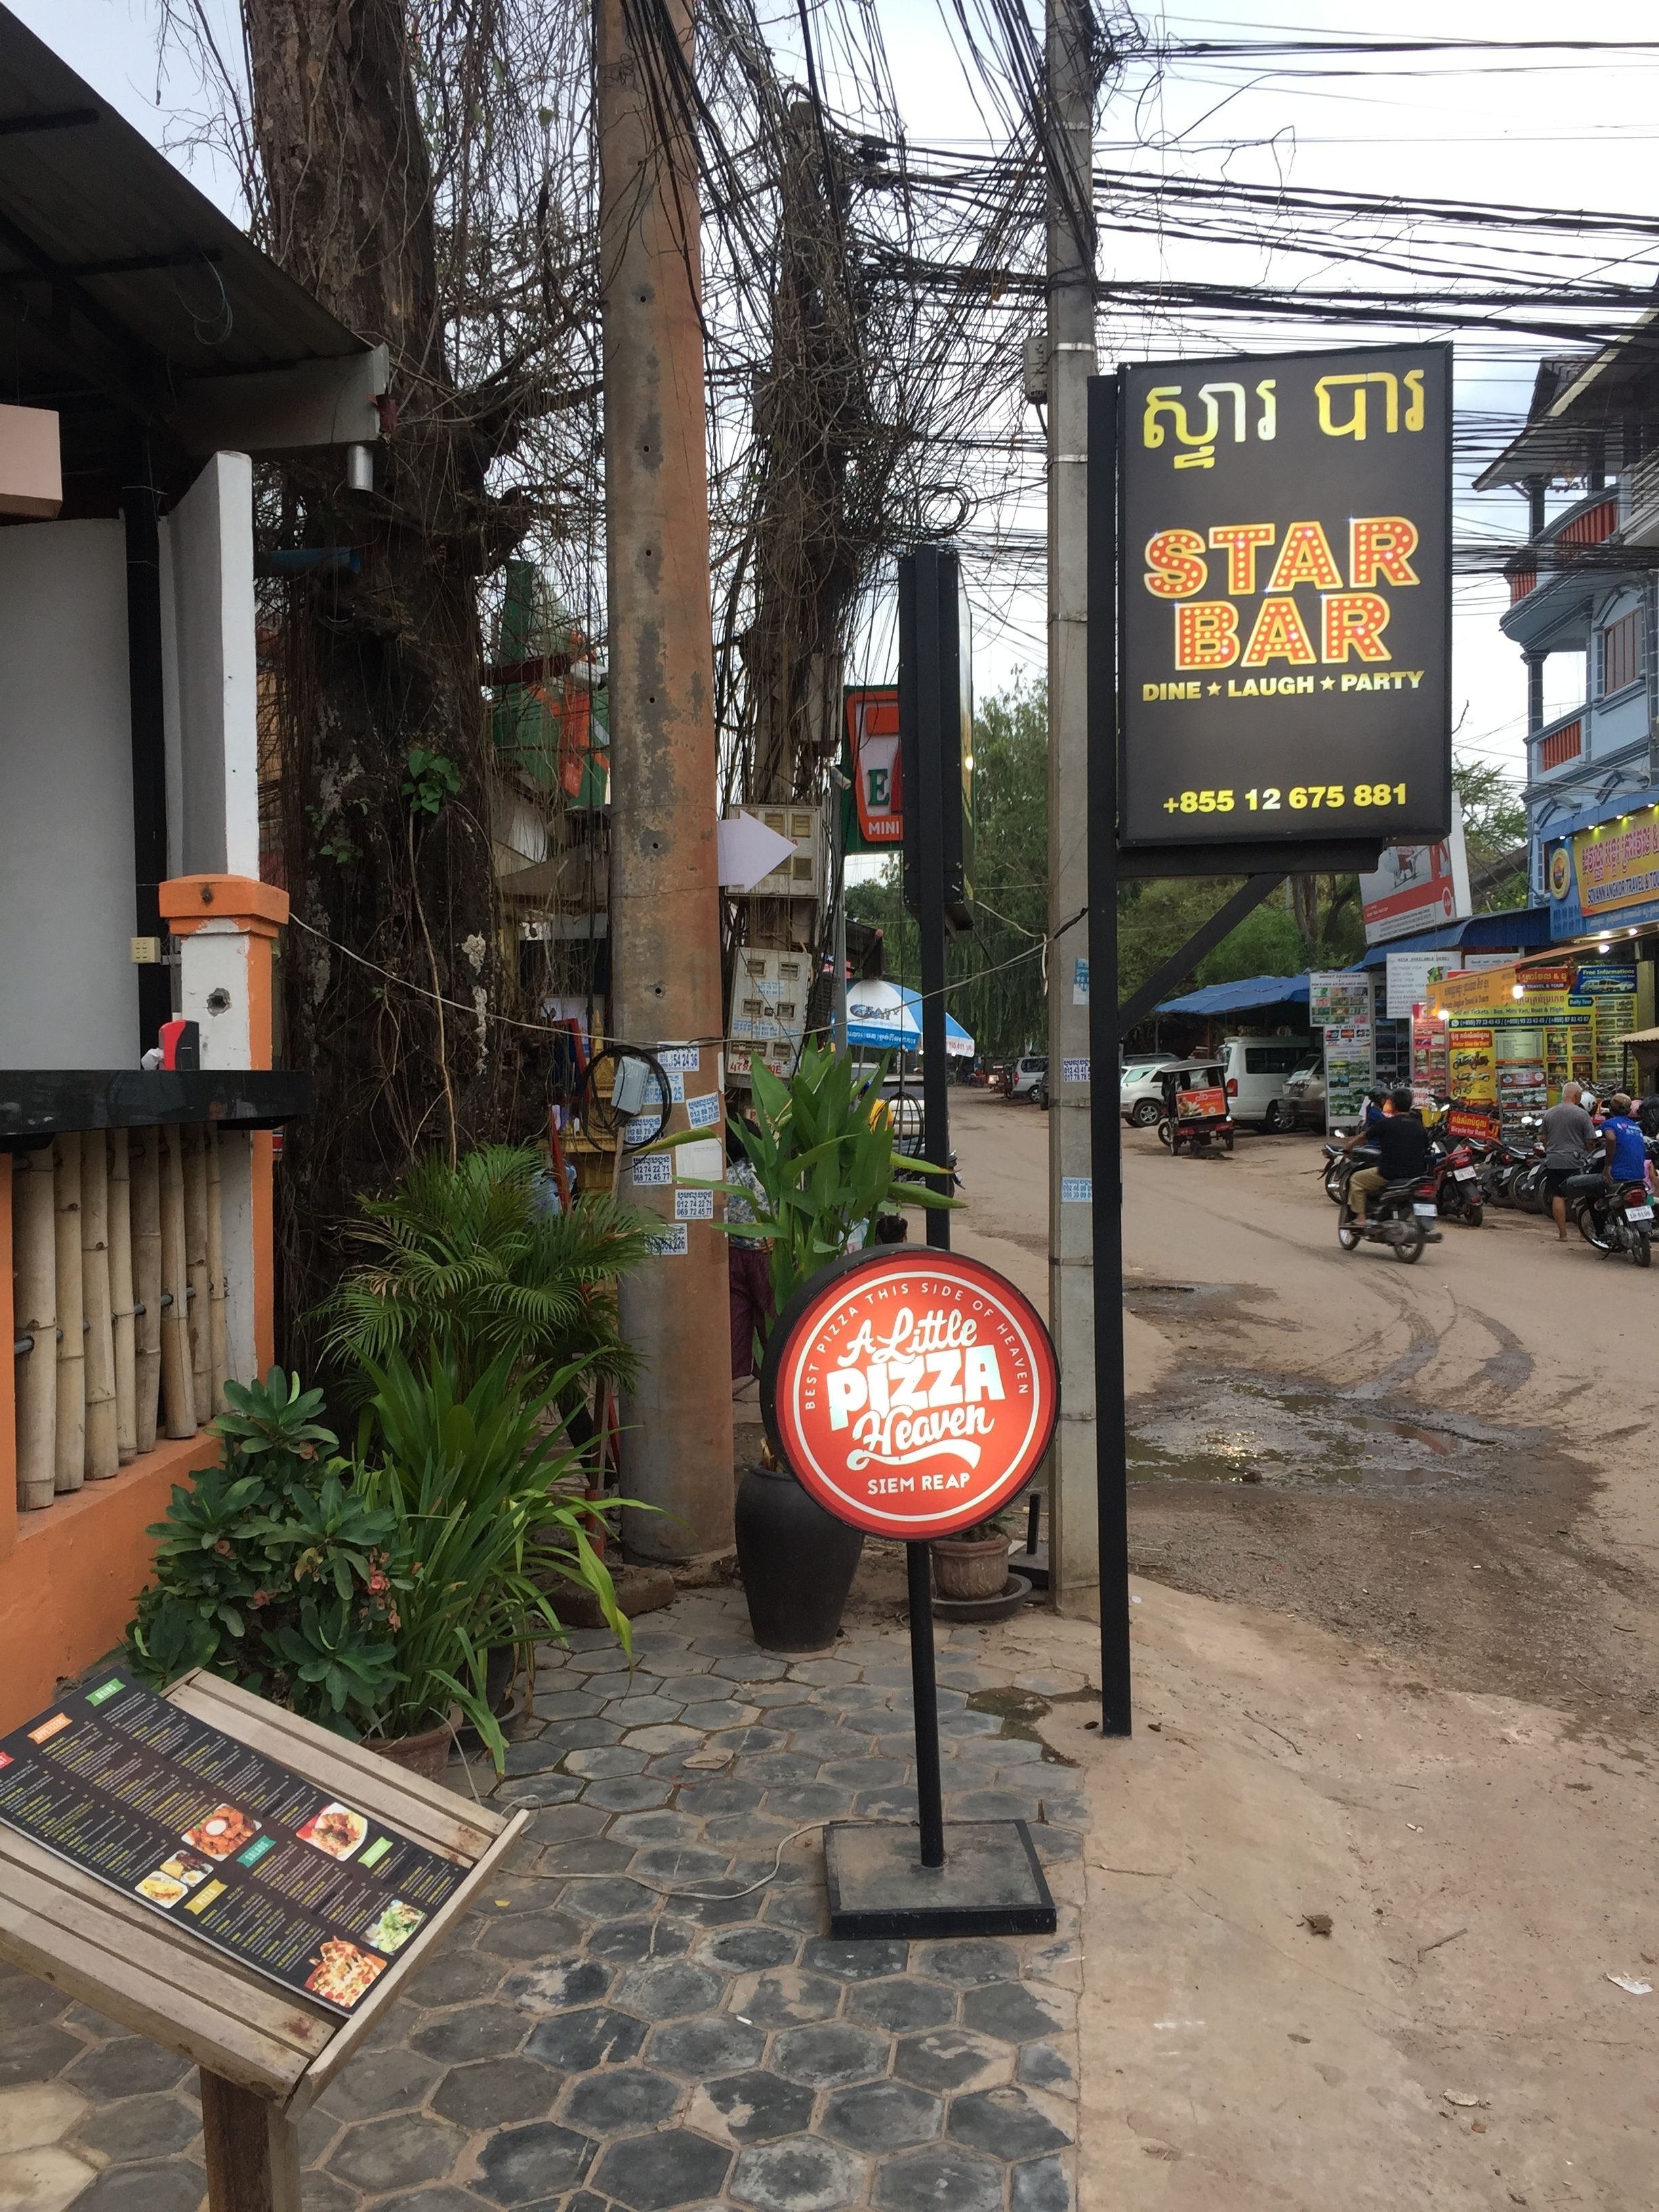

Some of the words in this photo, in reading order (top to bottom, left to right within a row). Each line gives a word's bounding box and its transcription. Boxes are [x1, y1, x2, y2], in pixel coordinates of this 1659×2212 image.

[1314, 369, 1424, 441] បារ
[1144, 516, 1420, 598] STAR
[1175, 593, 1392, 670] BAR
[1143, 682, 1202, 701] DINE
[1228, 676, 1314, 697] LAUGH
[1341, 670, 1424, 691] PARTY
[1163, 790, 1233, 813] +855
[1245, 788, 1281, 811] 12
[1289, 785, 1344, 808] 675
[1353, 783, 1407, 806] 881
[868, 821, 899, 835] MINI
[1626, 876, 1643, 893] TRAVEL
[682, 1054, 690, 1066] 24
[691, 1053, 698, 1066] 36
[674, 1086, 682, 1101] 25
[1451, 1126, 1467, 1134] Bicycle
[634, 1174, 643, 1182] 069
[805, 1364, 819, 1410] BEST
[817, 1307, 859, 1353] PIZZA
[865, 1283, 909, 1305] THIS
[922, 1283, 964, 1301] SIDE
[972, 1300, 994, 1317] OF
[996, 1323, 1029, 1394] HEAVEN
[837, 1319, 876, 1367] A
[872, 1307, 977, 1364] Little
[826, 1345, 1006, 1431] PIZZA
[852, 1404, 995, 1456] Heaven
[867, 1477, 914, 1495] SIEM
[922, 1472, 970, 1491] REAP
[95, 1683, 117, 1700] MAINS
[245, 1841, 269, 1862] SALADS
[195, 1888, 218, 1906] PIZZA
